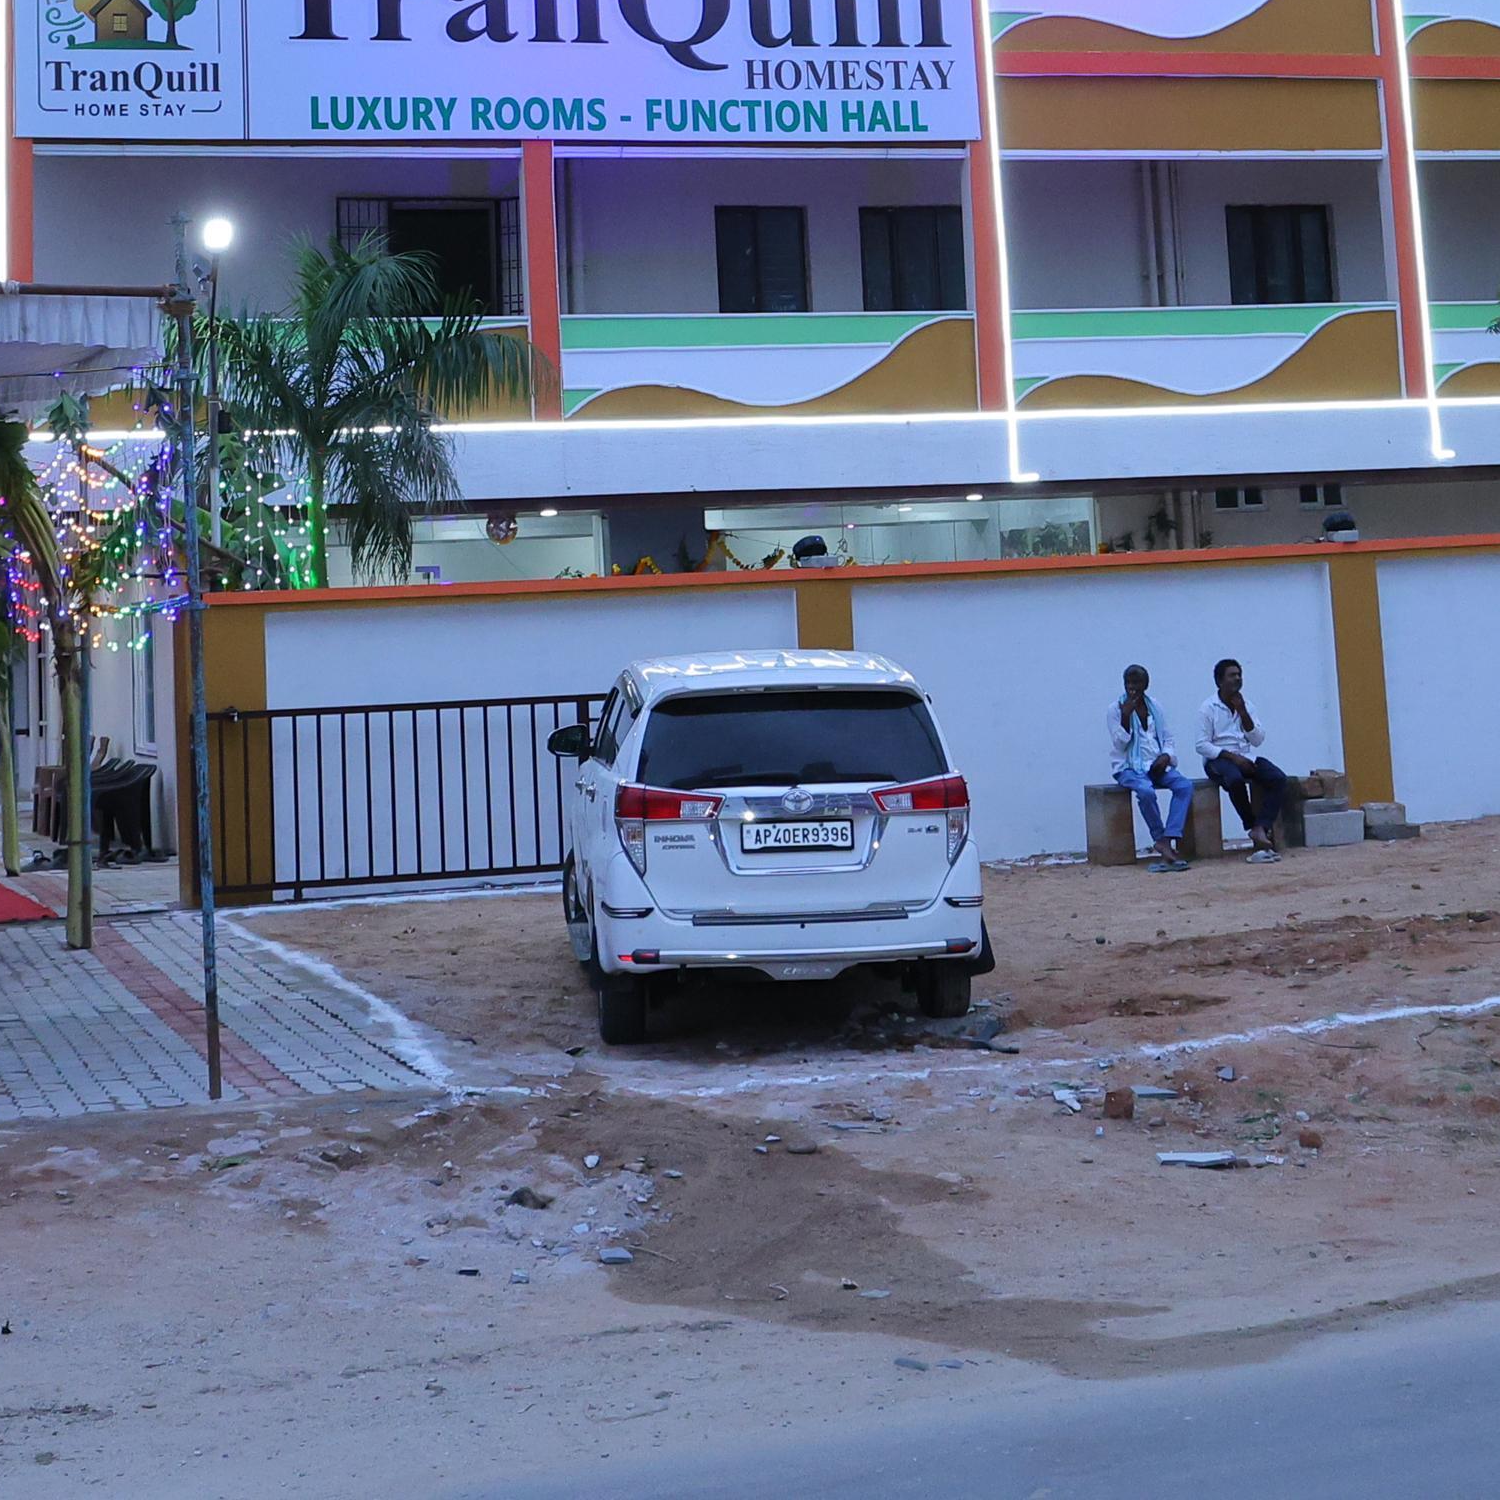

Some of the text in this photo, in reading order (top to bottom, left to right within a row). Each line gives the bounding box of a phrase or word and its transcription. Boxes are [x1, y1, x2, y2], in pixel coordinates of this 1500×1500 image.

[45, 60, 221, 99] TranQuill
[743, 59, 956, 91] HOMESTAY
[74, 103, 186, 117] HOME STAY
[310, 95, 458, 131] LUXURY
[471, 96, 608, 132] ROOMS
[645, 98, 829, 133] FUNCTION
[841, 100, 929, 133] HALL
[754, 825, 850, 846] AP40ER9396
